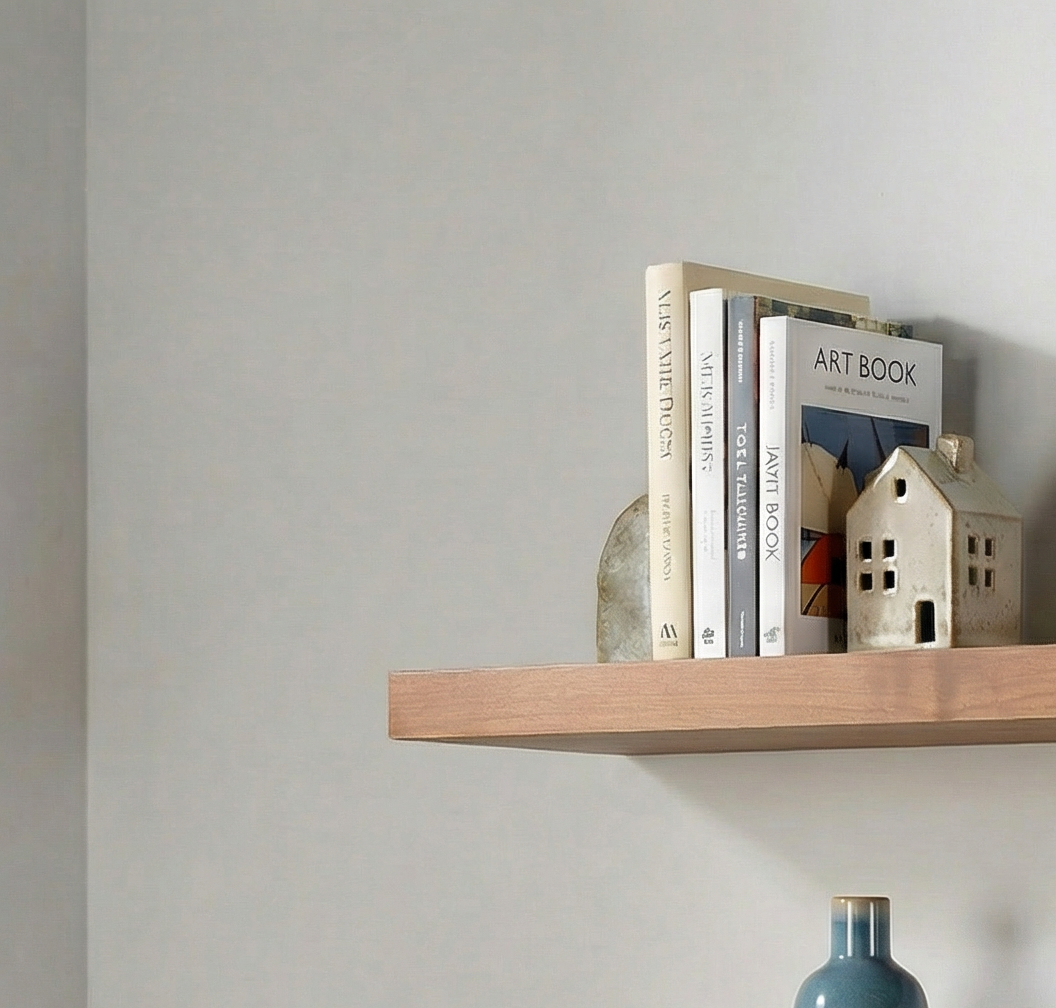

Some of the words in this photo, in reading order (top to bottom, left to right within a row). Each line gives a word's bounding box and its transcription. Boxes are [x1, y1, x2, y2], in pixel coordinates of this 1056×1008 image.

[814, 347, 853, 375] ART
[859, 354, 917, 387] BOOK
[765, 503, 781, 562] BOOK
